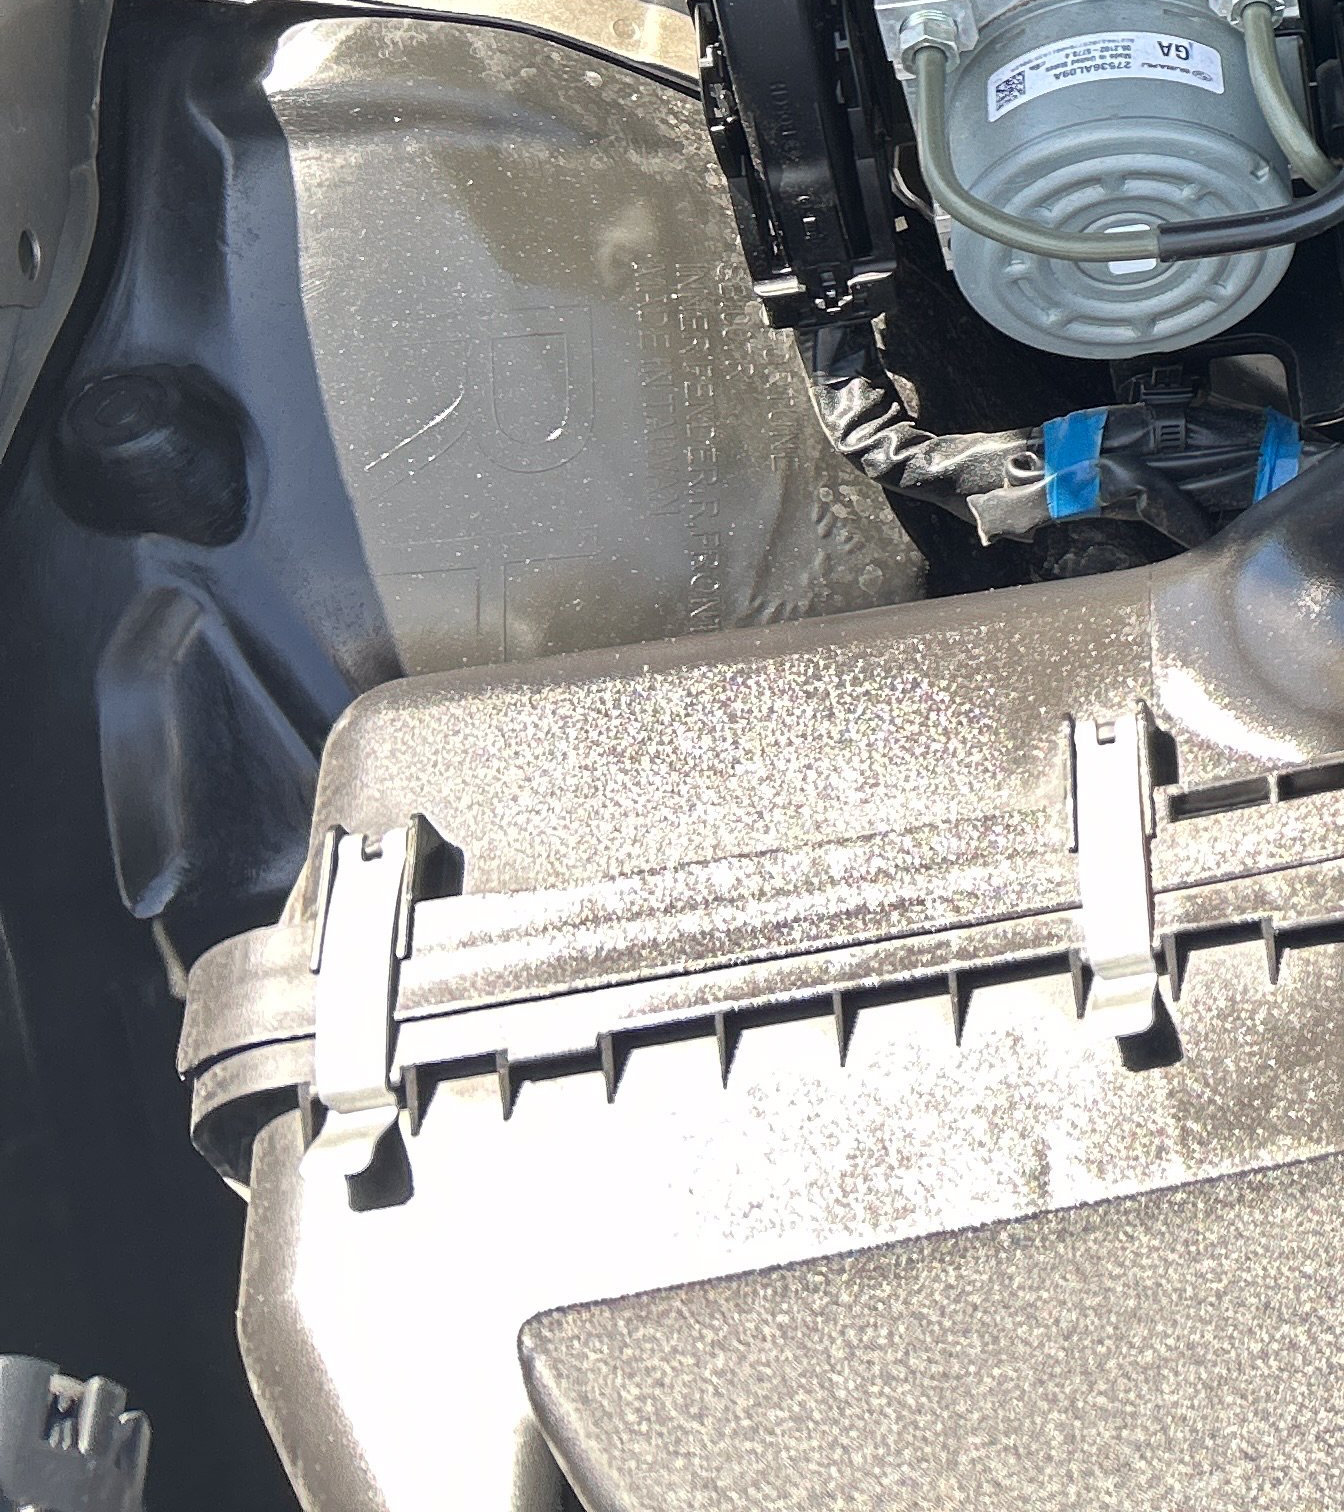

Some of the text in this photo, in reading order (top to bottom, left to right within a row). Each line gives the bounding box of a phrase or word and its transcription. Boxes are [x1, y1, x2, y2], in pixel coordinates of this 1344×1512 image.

[1157, 40, 1190, 61] GA
[633, 262, 671, 348] MADE
[644, 392, 680, 516] TAIWAN
